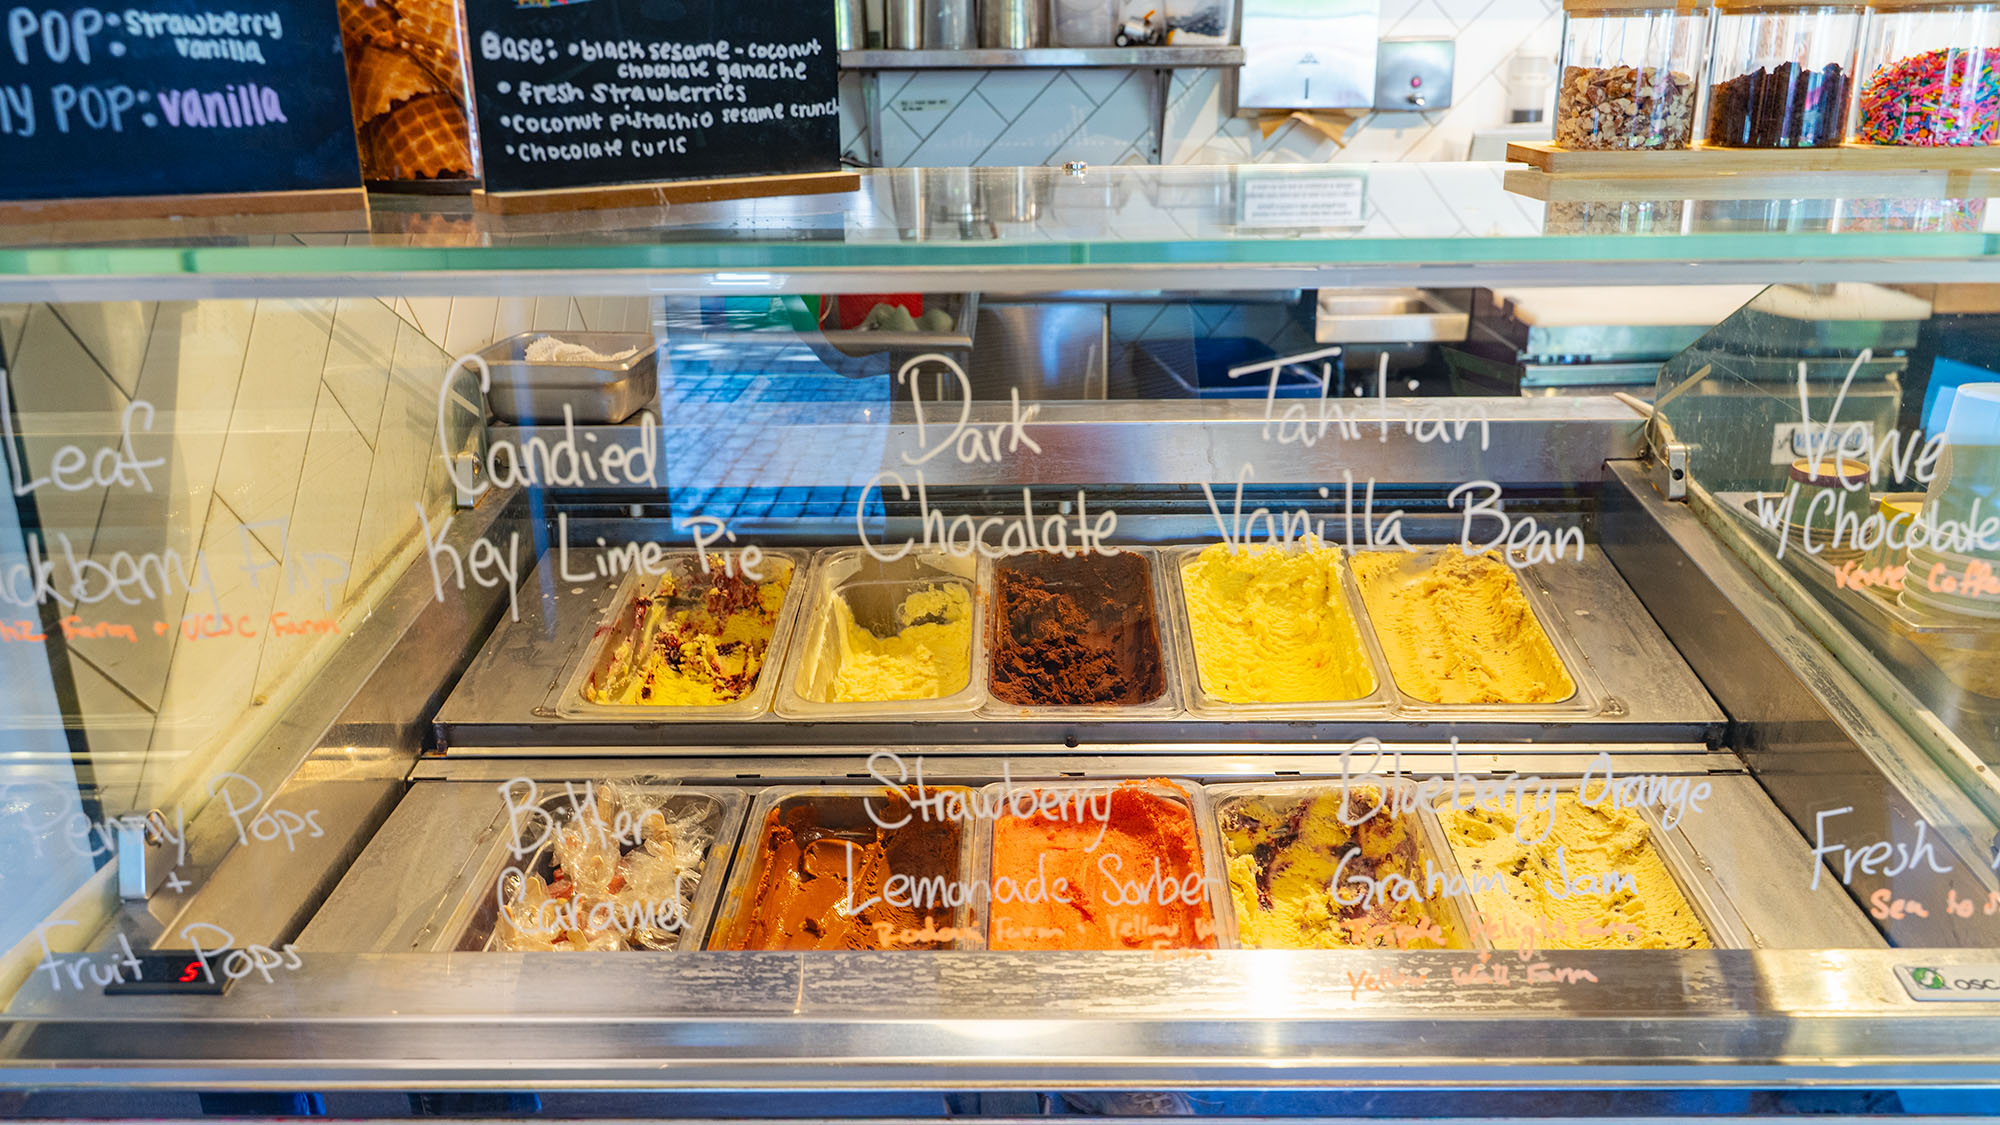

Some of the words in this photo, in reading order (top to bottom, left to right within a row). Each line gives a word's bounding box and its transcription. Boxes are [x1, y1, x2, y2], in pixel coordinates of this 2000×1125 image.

[174, 37, 266, 65] vanilla
[481, 30, 558, 64] Base:
[649, 40, 731, 62] sesame
[748, 38, 822, 59] coconut
[617, 61, 710, 79] chocolate
[716, 61, 807, 84] ganache
[157, 83, 288, 128] vanilla
[609, 104, 714, 132] pistachio
[722, 102, 785, 124] sesame
[631, 136, 688, 158] curls
[0, 367, 165, 496] Leaf
[438, 354, 657, 497] Candied
[898, 354, 1042, 466] Dark
[1228, 346, 1491, 452] Tahitian
[1798, 348, 1949, 491] Verve
[857, 469, 1121, 562] Chocolate
[1200, 463, 1418, 558] Vanilla
[1447, 479, 1585, 569] Bean
[1803, 488, 2000, 555] Chocolate
[416, 502, 520, 623] Key
[558, 512, 668, 582] Lime
[680, 515, 764, 580] Pie
[208, 773, 325, 852] Pops
[498, 777, 661, 861] Bitter
[863, 752, 1114, 853] Strawberry
[1337, 736, 1557, 846] Blueberry
[1579, 752, 1712, 831] Orange
[846, 841, 1072, 915] Lemonade
[1097, 853, 1222, 907] Sorbet
[1331, 846, 1509, 910] Graham
[1544, 846, 1640, 900] Jam
[1811, 806, 1953, 891] Fresh
[497, 867, 692, 934] Caramel
[36, 920, 144, 991] Fruit
[180, 922, 303, 984] Pops
